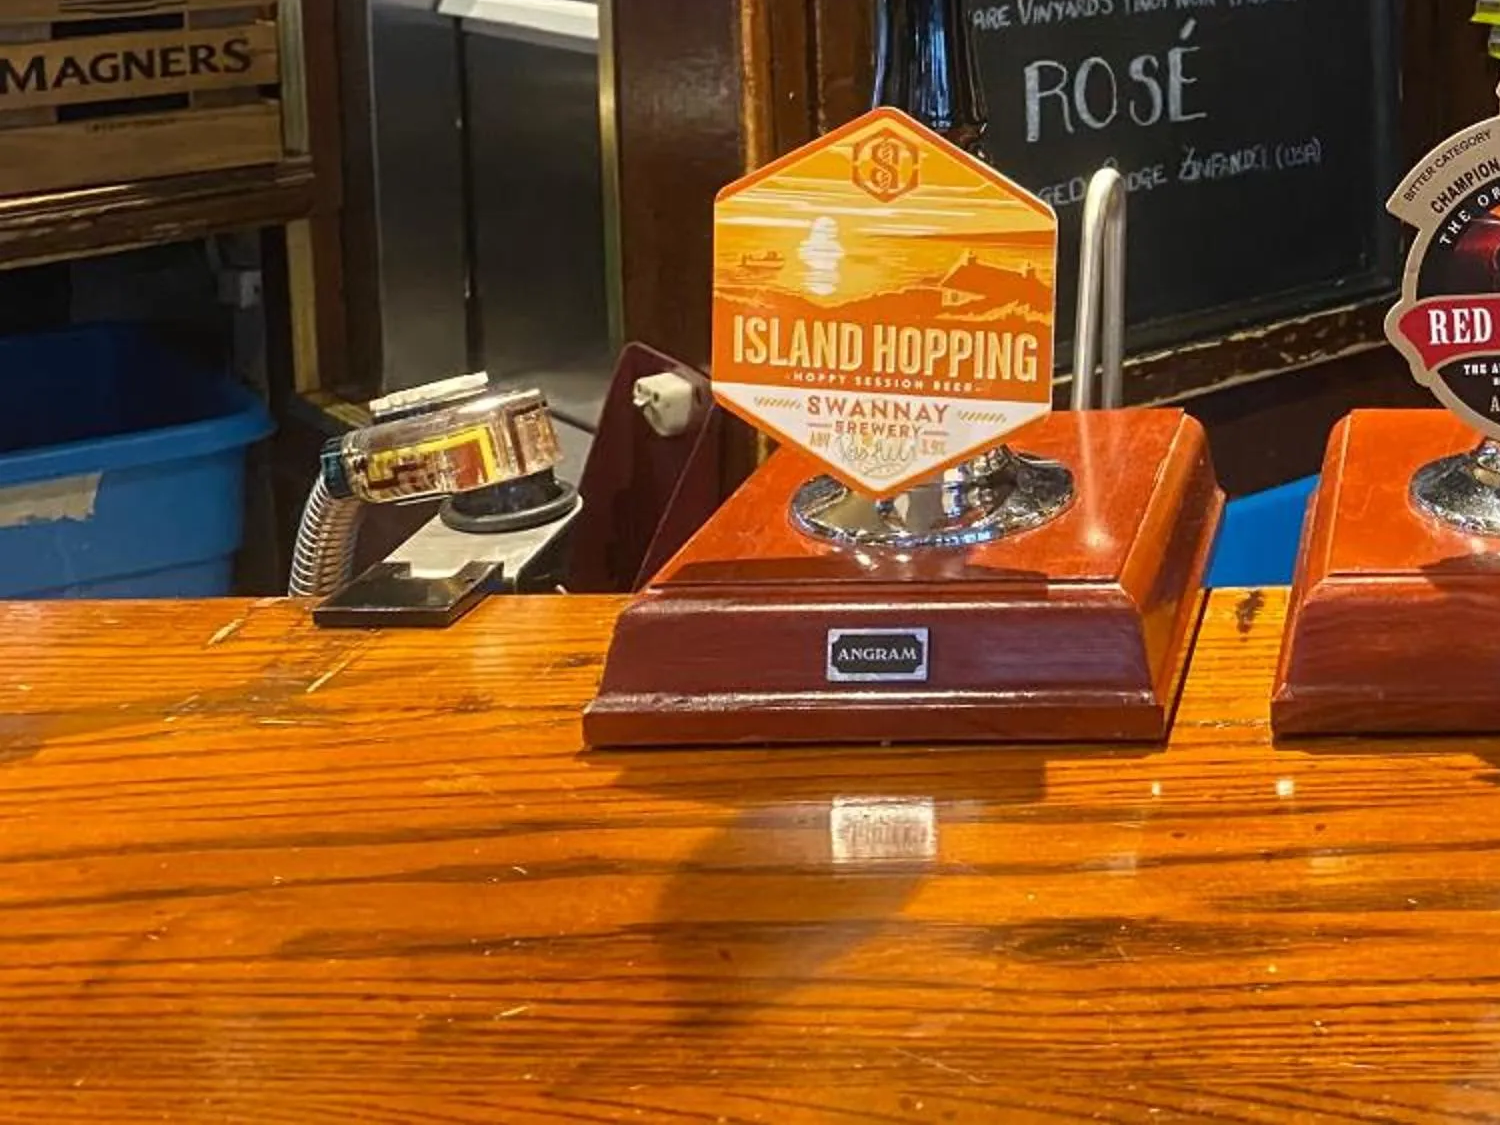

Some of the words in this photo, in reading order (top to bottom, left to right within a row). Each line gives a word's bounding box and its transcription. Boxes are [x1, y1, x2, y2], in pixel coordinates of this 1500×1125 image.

[972, 4, 1013, 31] ARE
[0, 38, 253, 95] MAGNERS
[1022, 18, 1208, 143] ROSÉ
[1402, 165, 1437, 203] BITTER
[1434, 128, 1493, 169] CATEGORY
[1430, 157, 1500, 215] CHAMPION
[1439, 209, 1472, 246] THE
[1427, 306, 1493, 346] RED
[732, 314, 864, 373] ISLAND
[871, 324, 1038, 383] HOPPING
[793, 372, 847, 386] HOPPY
[854, 376, 924, 391] SESSION
[1463, 363, 1487, 376] THE
[806, 394, 951, 424] SWANNAY
[834, 420, 922, 440] BREWERY
[837, 646, 918, 661] ANGRAM
